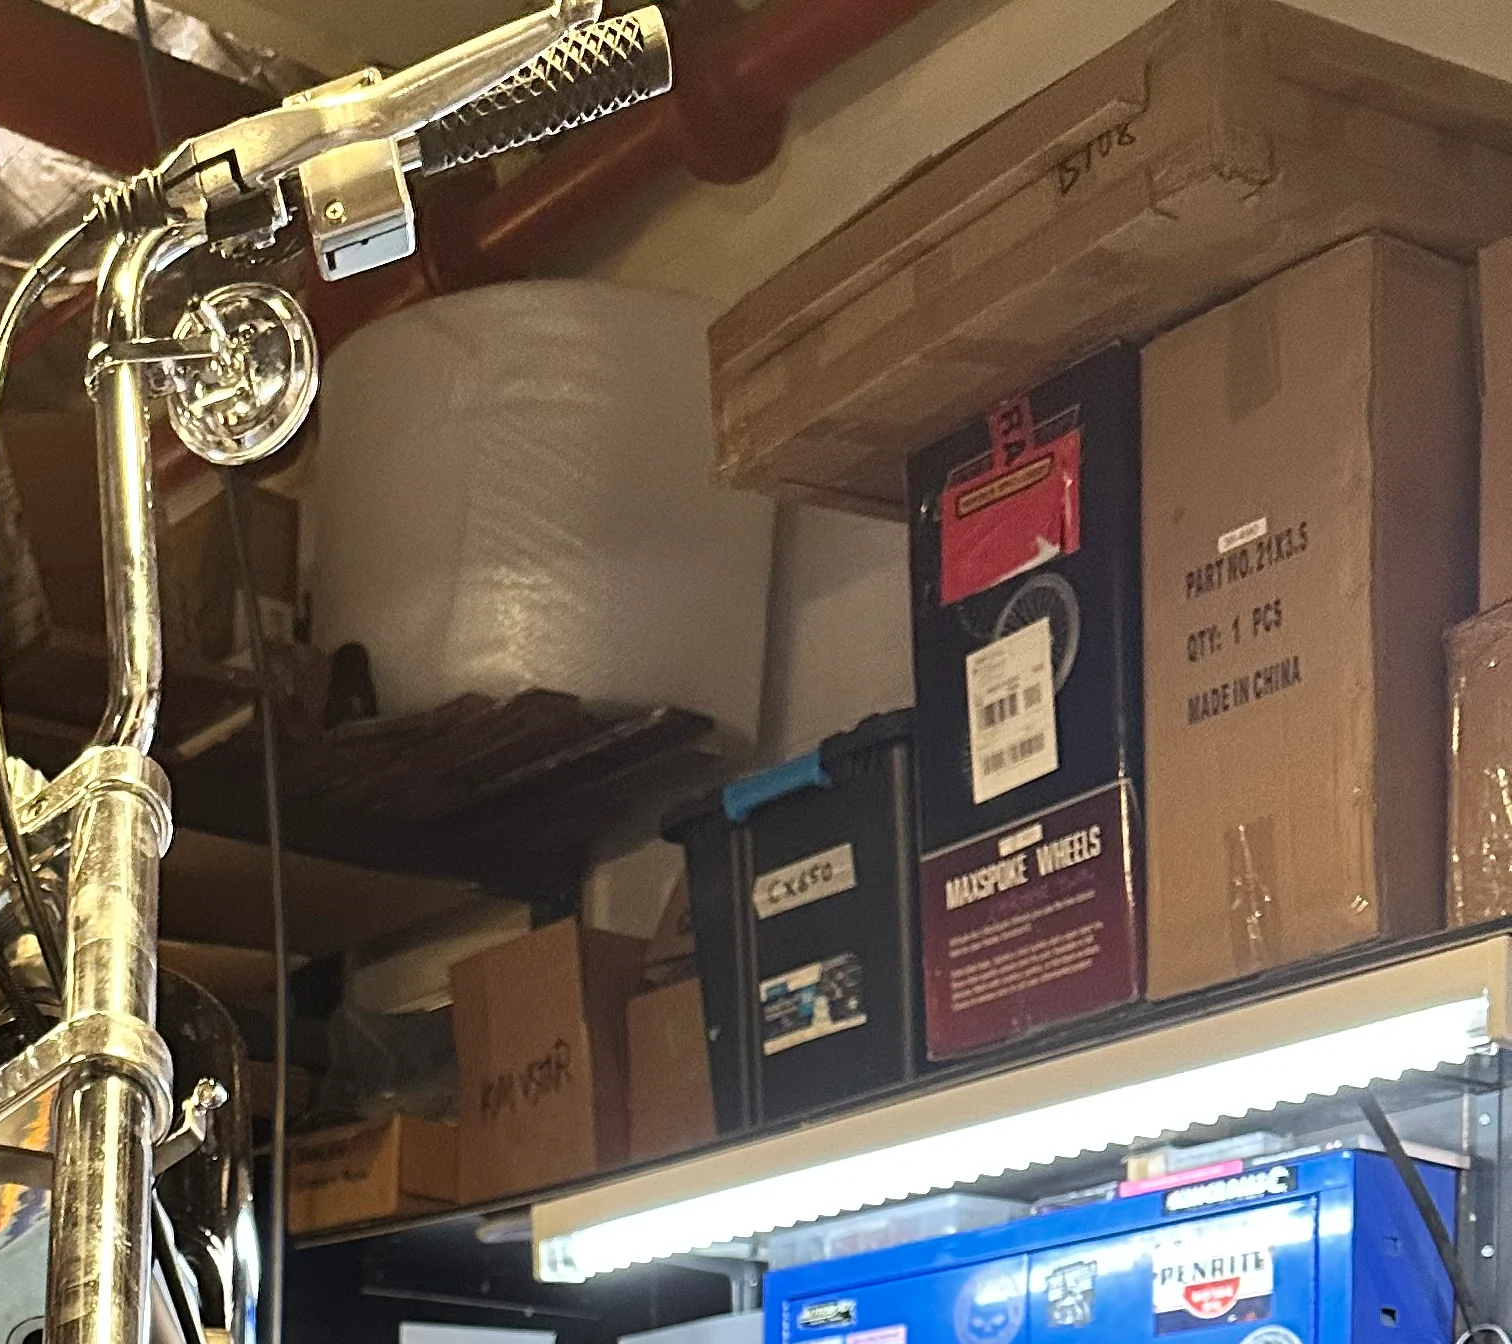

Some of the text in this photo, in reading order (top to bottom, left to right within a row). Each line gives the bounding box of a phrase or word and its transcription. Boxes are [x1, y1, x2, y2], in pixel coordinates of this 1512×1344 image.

[1185, 556, 1224, 600] PART
[1186, 598, 1282, 663] QTY: 1 PCS
[1187, 655, 1302, 726] MADE IN CHINA
[944, 852, 1030, 912] MAXSPOKE
[1035, 823, 1103, 877] WHEELS
[1159, 1250, 1266, 1287] PENRITE
